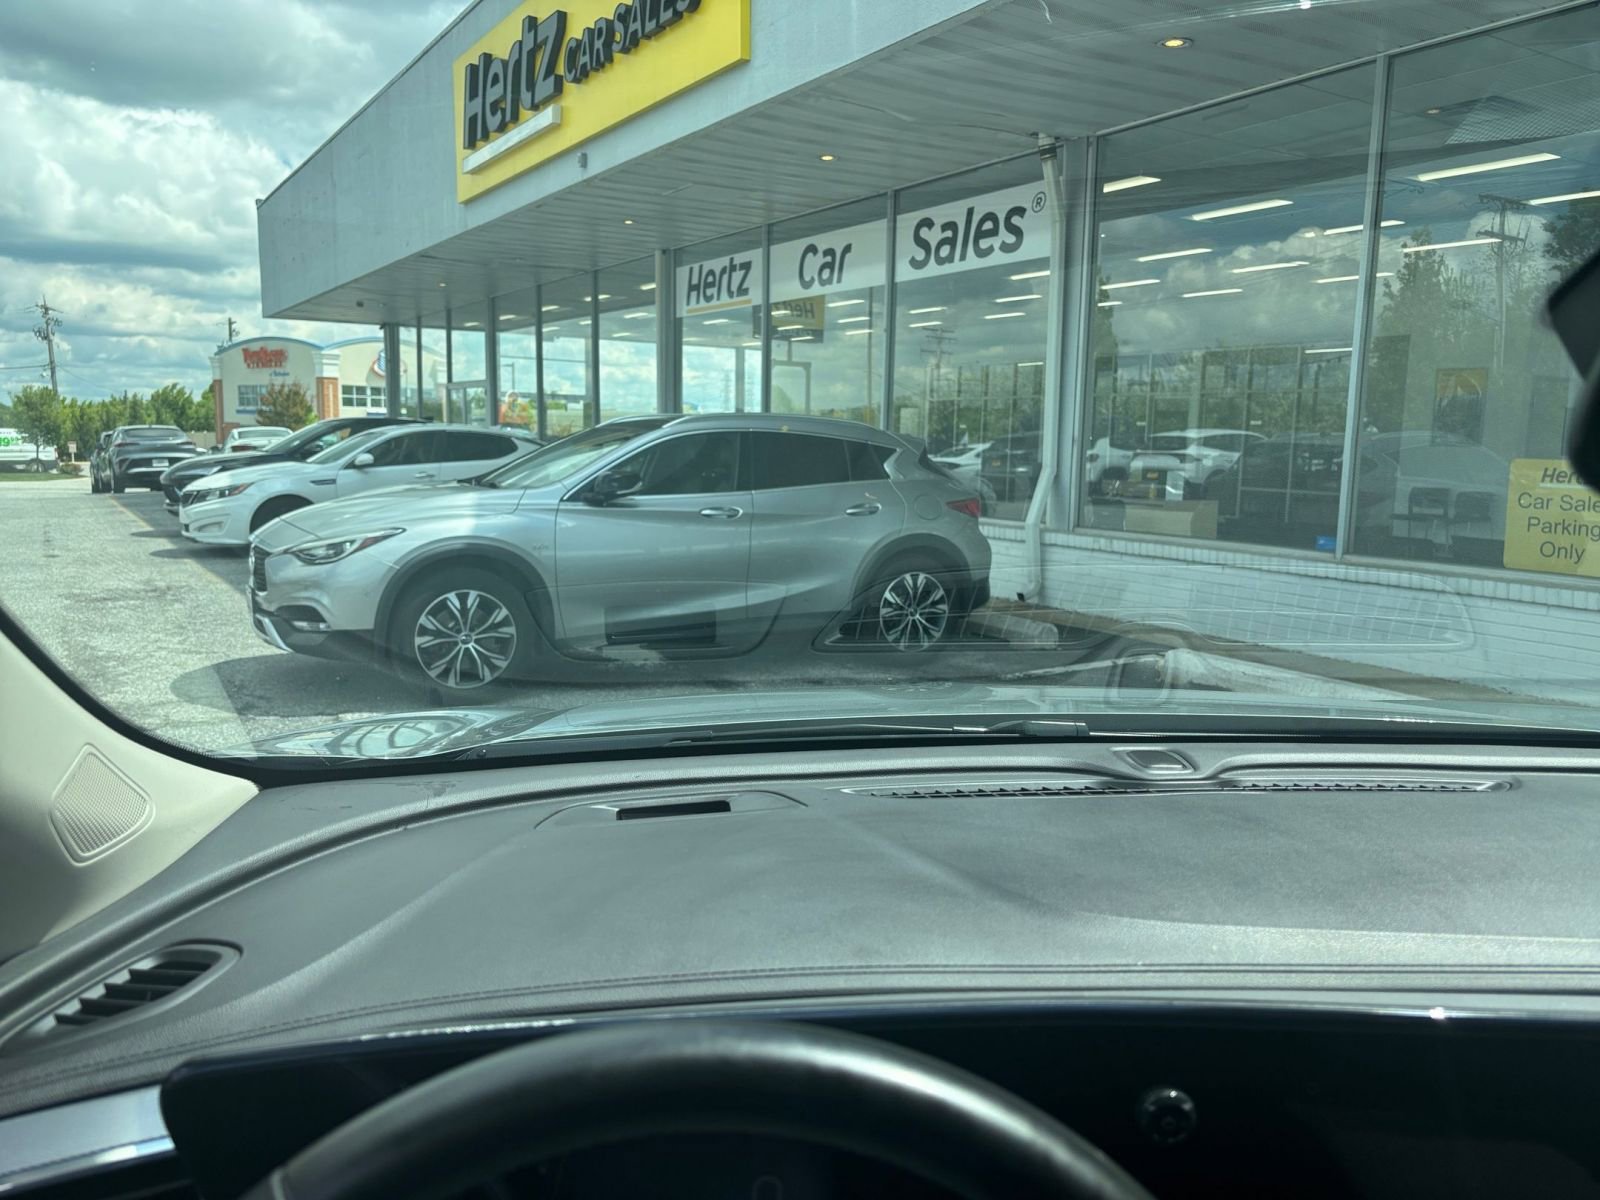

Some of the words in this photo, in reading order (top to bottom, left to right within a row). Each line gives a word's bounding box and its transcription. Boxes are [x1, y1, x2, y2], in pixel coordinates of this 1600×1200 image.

[463, 10, 567, 149] Hertz
[564, 17, 614, 84] CAR
[612, 0, 700, 54] SALE
[685, 256, 753, 306] Hertz
[798, 242, 853, 290] Car
[907, 205, 1028, 271] Sales
[1518, 491, 1554, 510] Car
[1527, 516, 1600, 542] Parking
[1540, 541, 1586, 565] Only
